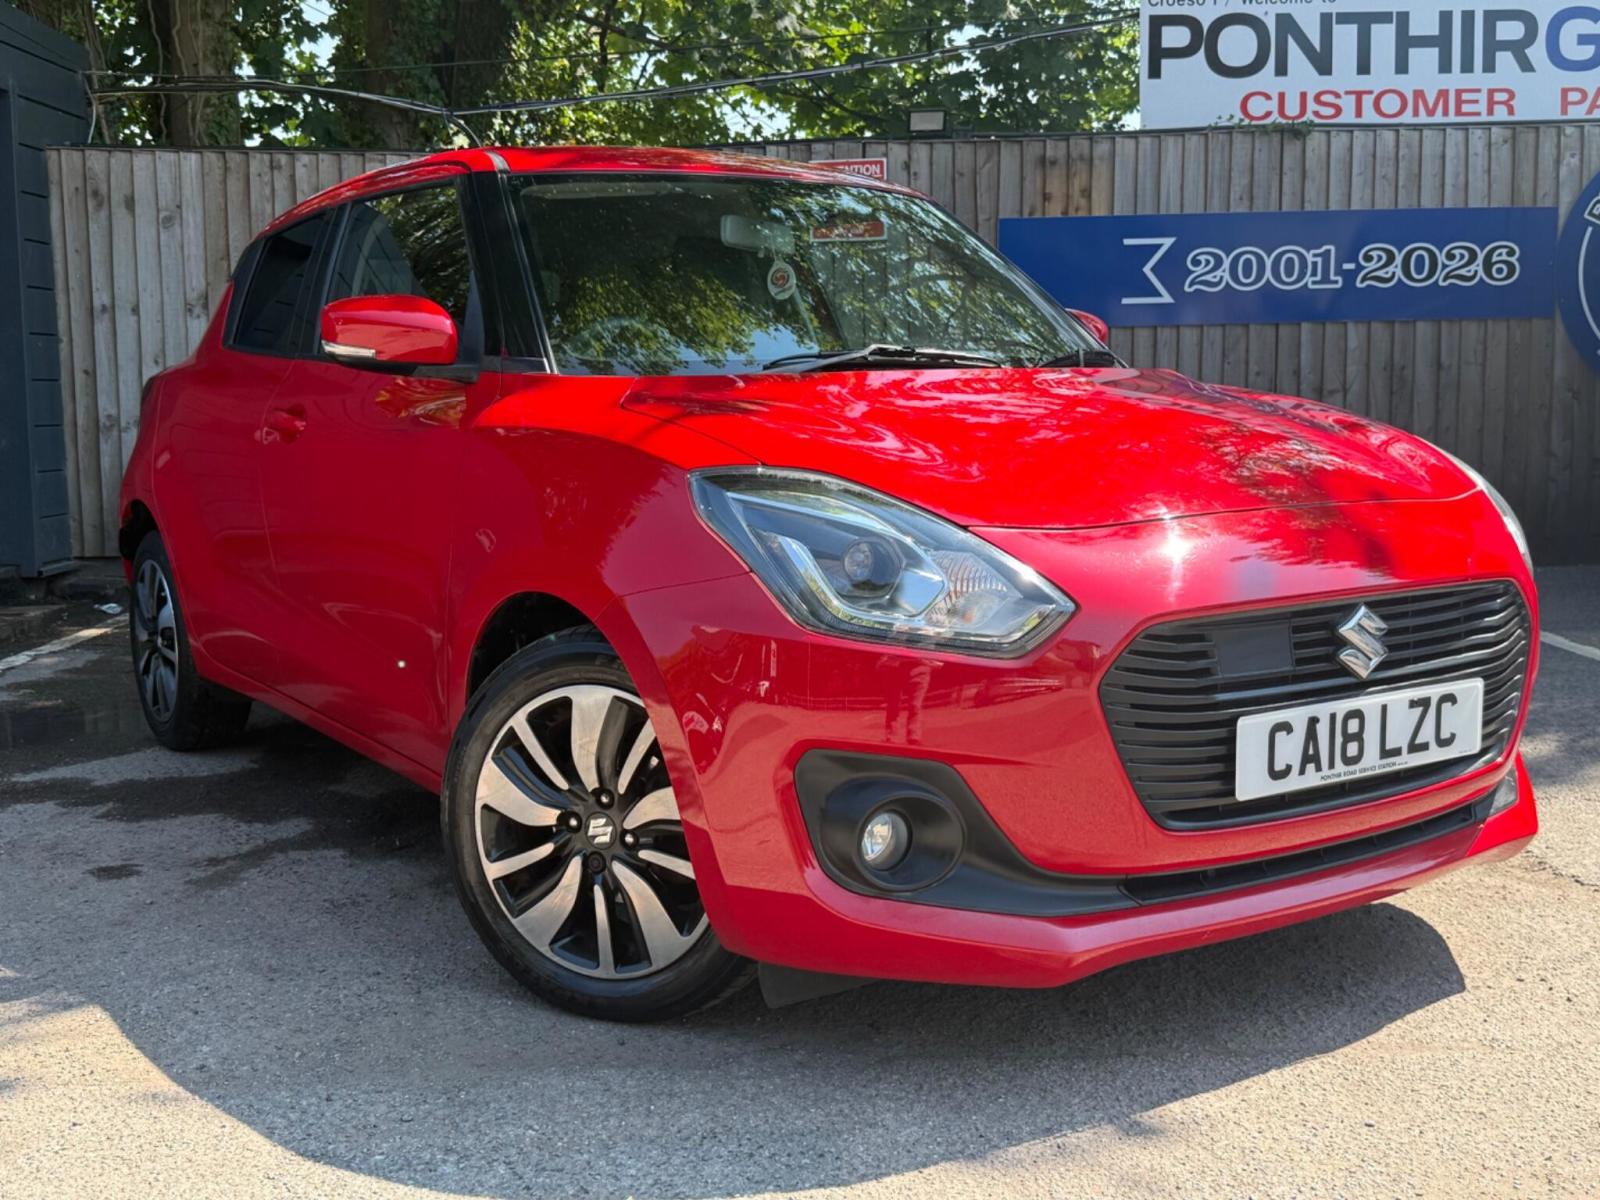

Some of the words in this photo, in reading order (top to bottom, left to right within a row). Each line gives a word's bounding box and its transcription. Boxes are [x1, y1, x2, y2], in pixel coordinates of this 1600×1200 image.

[1239, 88, 1516, 121] CUSTOMER
[1184, 241, 1520, 292] 2001-2026
[1267, 708, 1366, 781] CA18
[1379, 692, 1458, 760] LZC
[1343, 768, 1358, 778] ROAD
[1358, 765, 1377, 775] SERVICE
[1377, 761, 1397, 771] STATION
